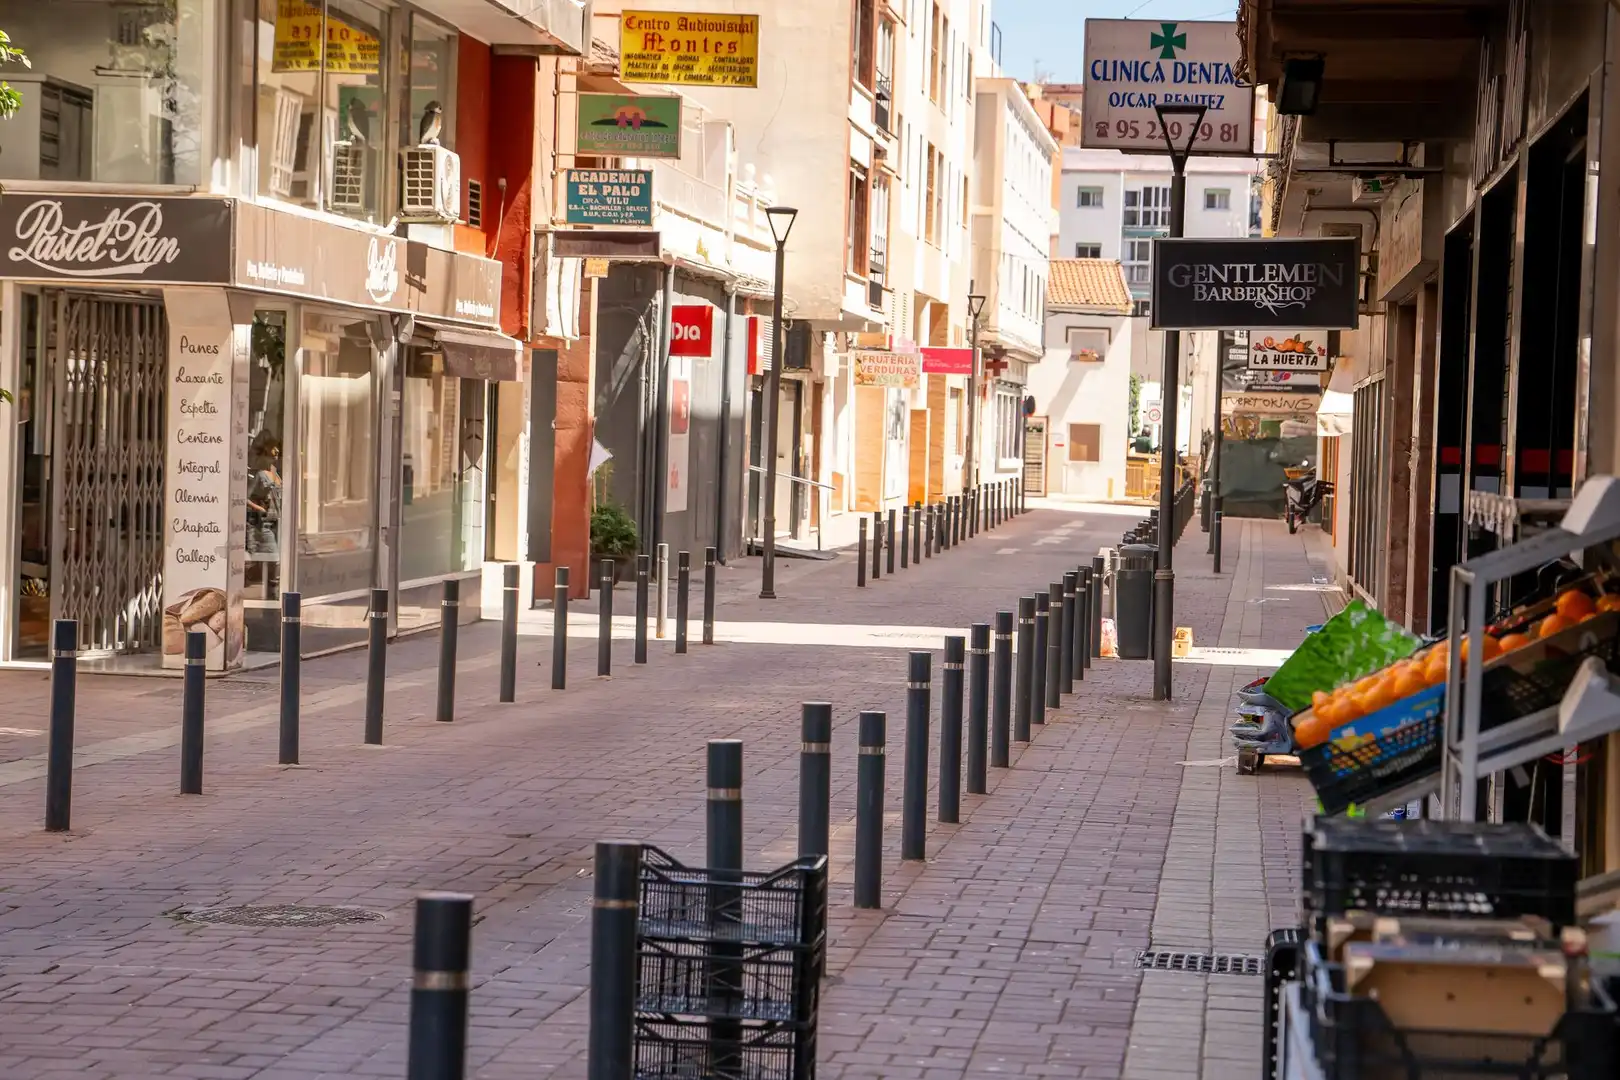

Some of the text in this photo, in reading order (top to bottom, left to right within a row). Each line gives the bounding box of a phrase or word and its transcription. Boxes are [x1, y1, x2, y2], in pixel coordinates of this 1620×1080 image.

[625, 15, 754, 34] Centro Audiovisual
[642, 31, 738, 54] Montes
[1091, 59, 1166, 84] CLINICA
[1108, 91, 1158, 109] OSCAR
[1116, 119, 1140, 139] 95
[1219, 122, 1240, 143] 81
[570, 171, 646, 184] ACADEMIA
[578, 183, 641, 197] EL PALO
[605, 196, 630, 205] VILU
[1167, 262, 1345, 289] GENTLEMEN
[180, 335, 219, 355] Panes
[860, 364, 918, 376] VERDURAS
[1253, 354, 1269, 365] LA
[1273, 354, 1320, 367] HUERTA
[175, 366, 224, 385] Laxante
[180, 398, 219, 419] Espelta
[177, 428, 224, 445] Centeno
[177, 458, 222, 482] Integral
[175, 488, 220, 504] Alemán
[173, 517, 222, 538] Chapata
[176, 547, 216, 571] Gallego
